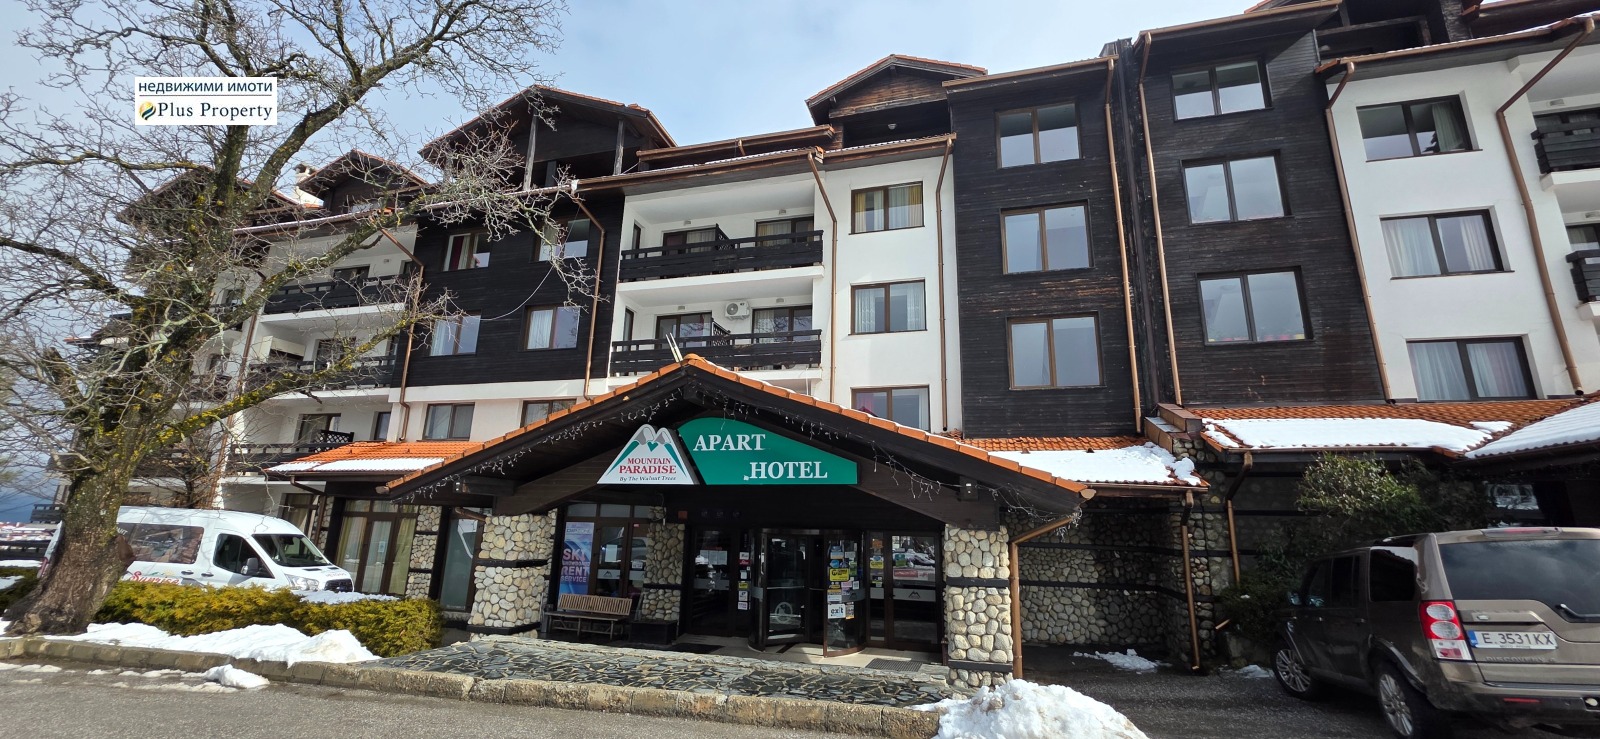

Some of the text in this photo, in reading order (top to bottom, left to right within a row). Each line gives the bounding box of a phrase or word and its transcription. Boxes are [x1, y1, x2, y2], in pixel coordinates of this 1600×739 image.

[692, 433, 766, 451] APART
[627, 457, 671, 465] MOUNTAIN
[618, 465, 677, 474] PARADISE
[749, 461, 828, 479] HOTEL
[562, 548, 586, 561] SKI
[560, 565, 589, 577] RENT
[131, 570, 181, 585] Sunrise
[560, 575, 587, 583] SERVICE
[830, 606, 844, 615] exit
